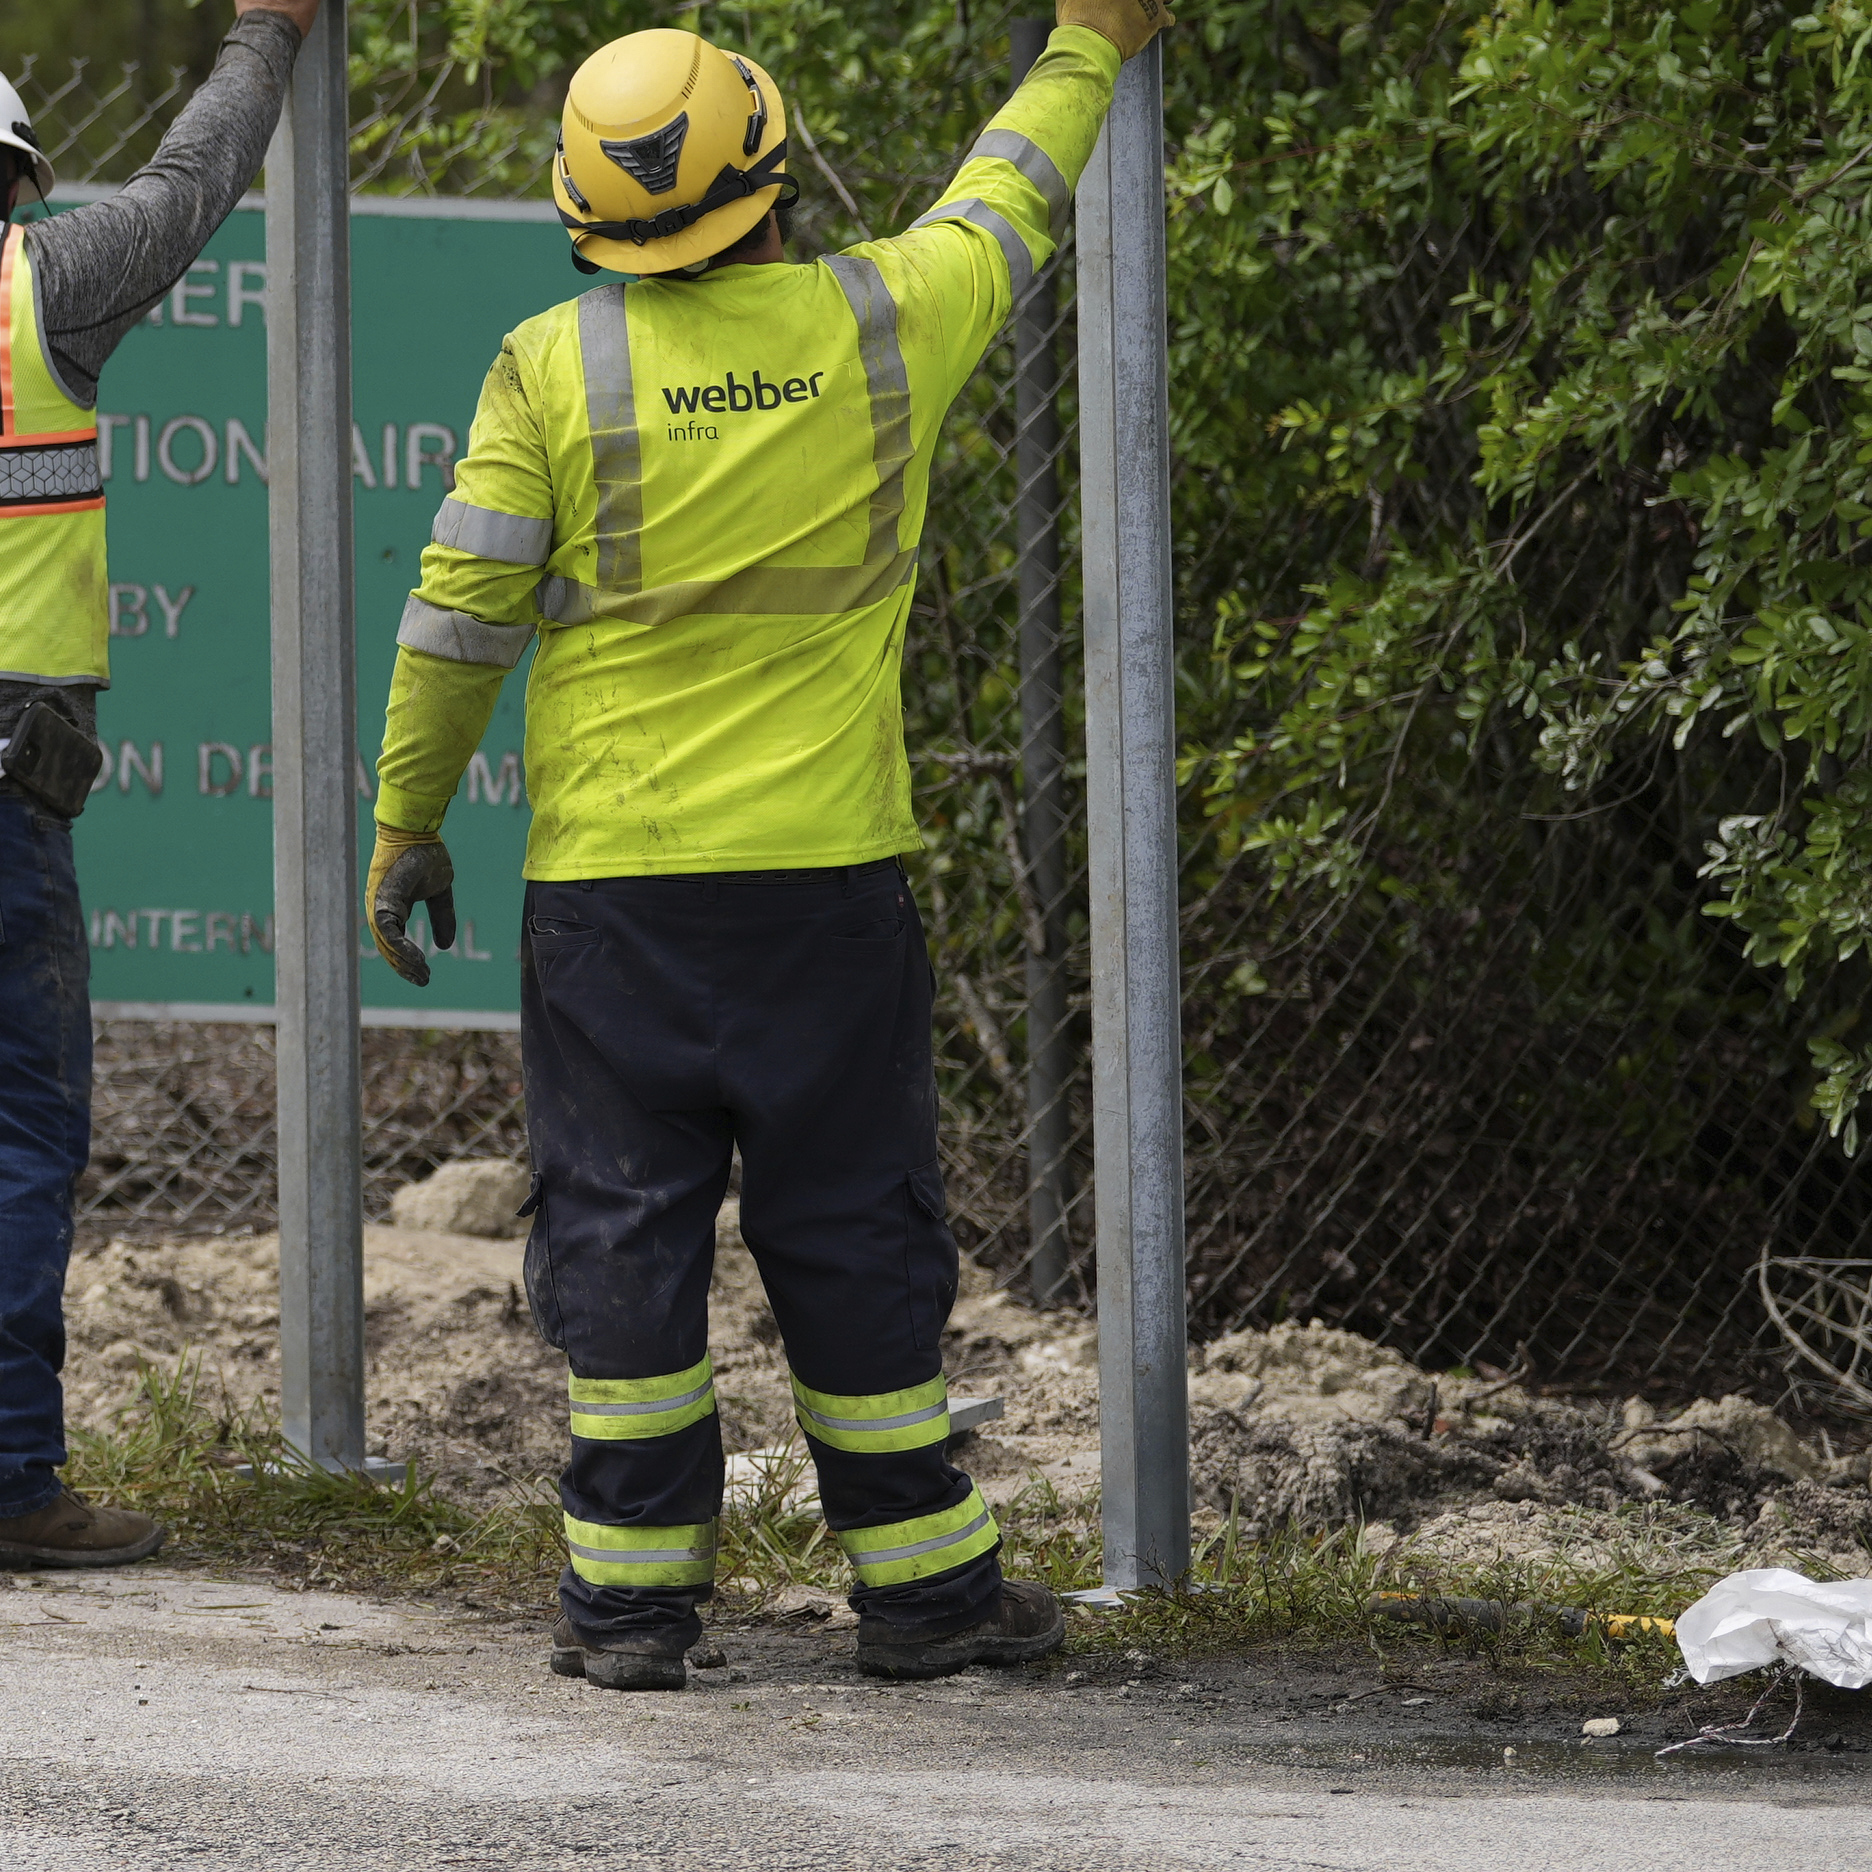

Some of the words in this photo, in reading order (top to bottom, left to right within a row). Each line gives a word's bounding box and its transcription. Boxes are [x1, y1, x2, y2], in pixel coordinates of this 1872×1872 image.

[662, 370, 823, 414] webber
[667, 420, 719, 441] infra
[352, 422, 457, 491] AIR
[109, 583, 196, 638] BY
